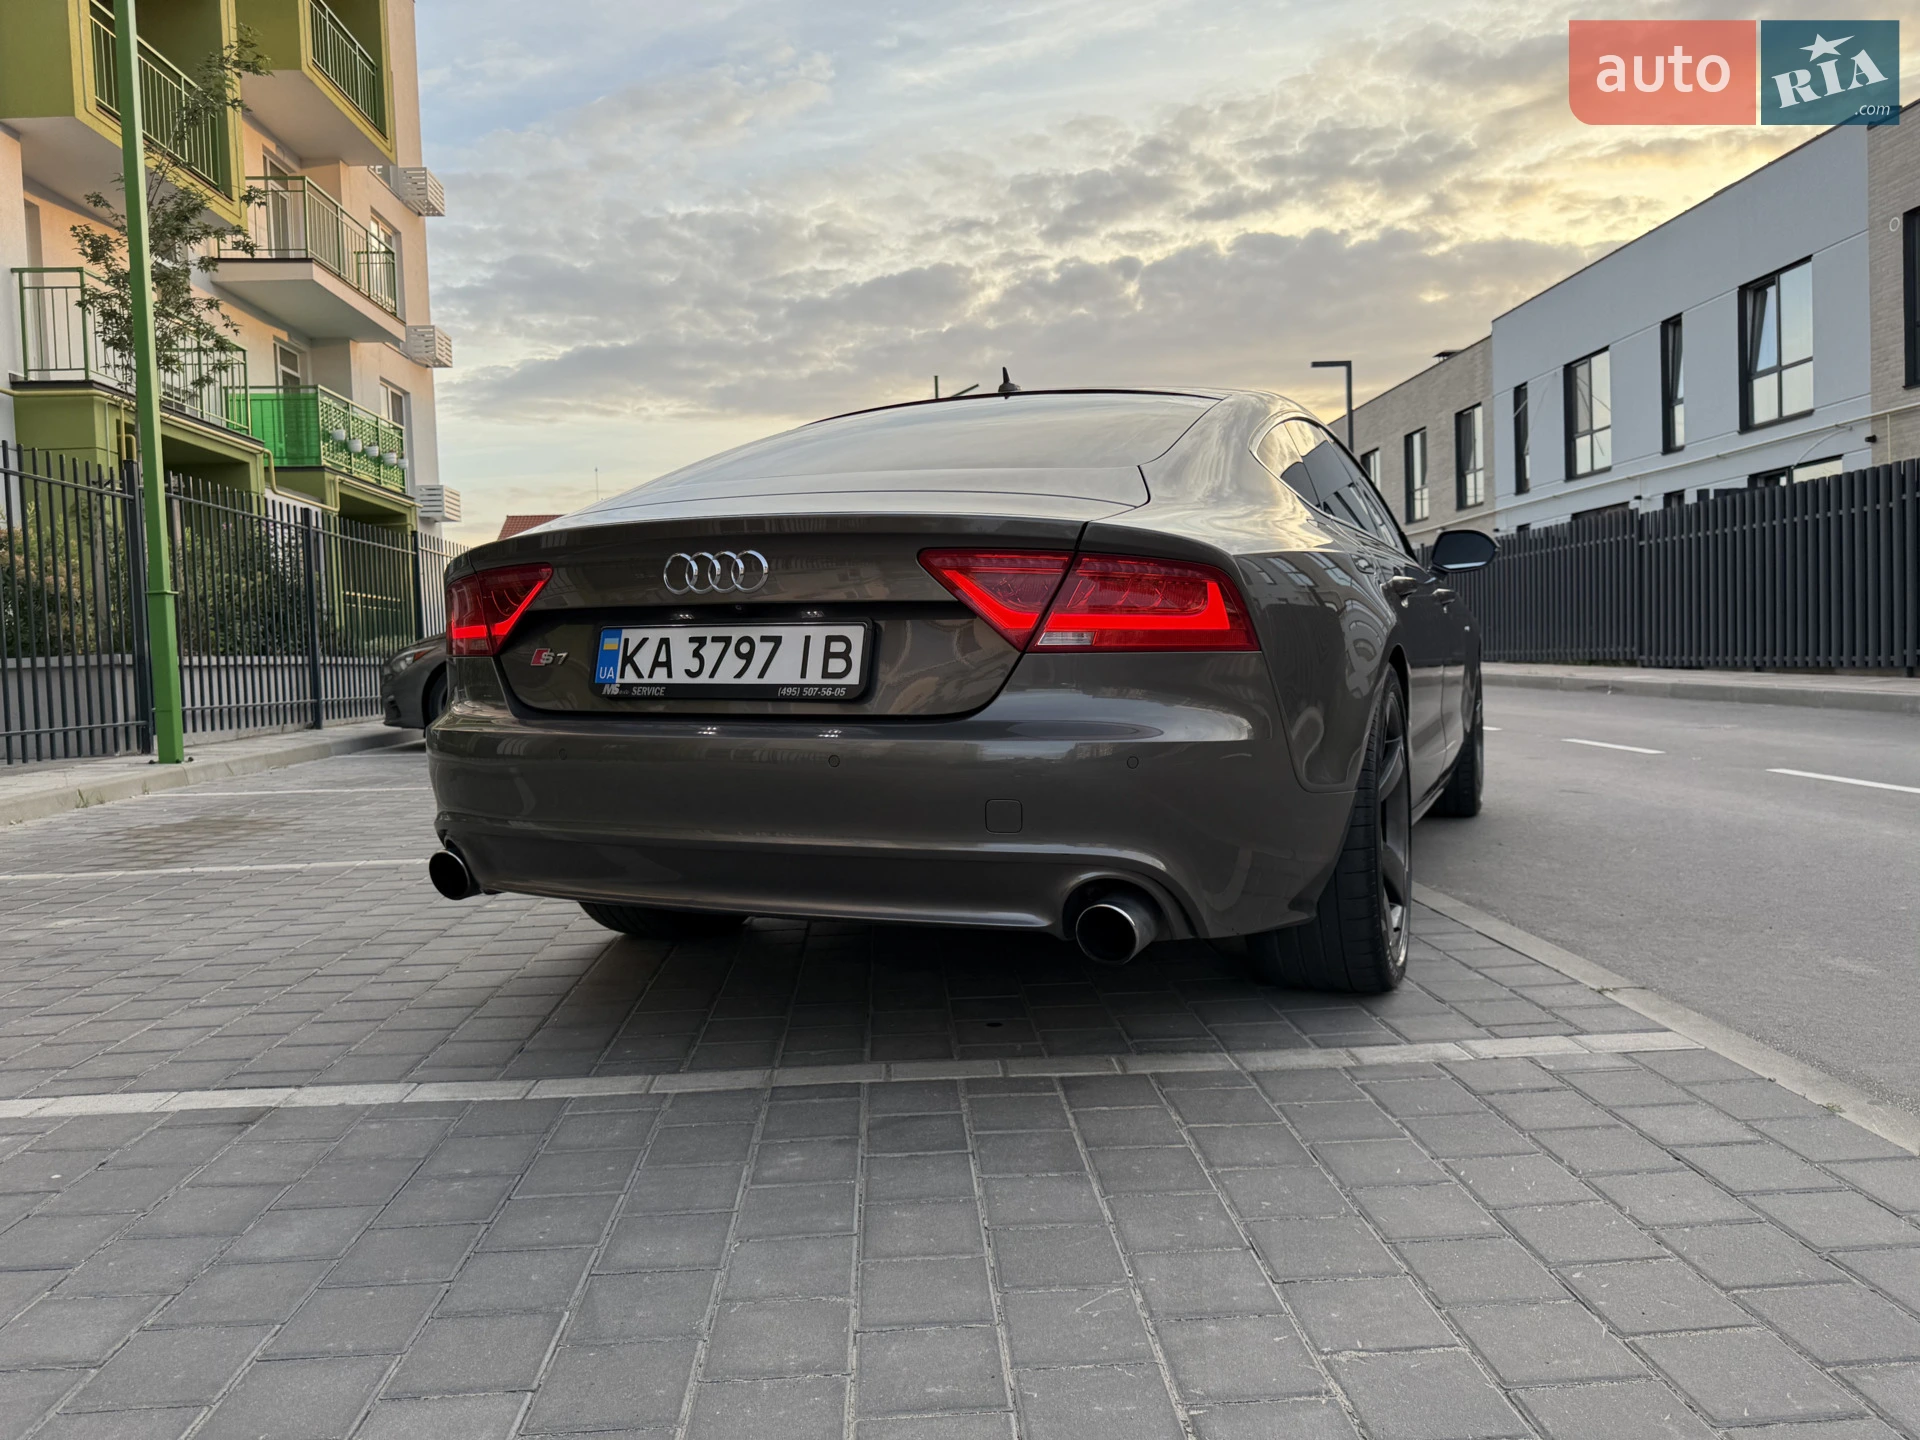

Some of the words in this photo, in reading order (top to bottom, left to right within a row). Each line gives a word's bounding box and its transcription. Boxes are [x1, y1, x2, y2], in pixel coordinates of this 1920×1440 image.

[540, 651, 568, 665] S7
[619, 636, 674, 680] KA
[684, 635, 783, 679] 3797
[799, 634, 853, 680] IB
[599, 666, 615, 680] UA
[631, 686, 667, 696] SERVICE
[778, 687, 800, 697] (495)
[802, 687, 847, 697] 507-56-05
